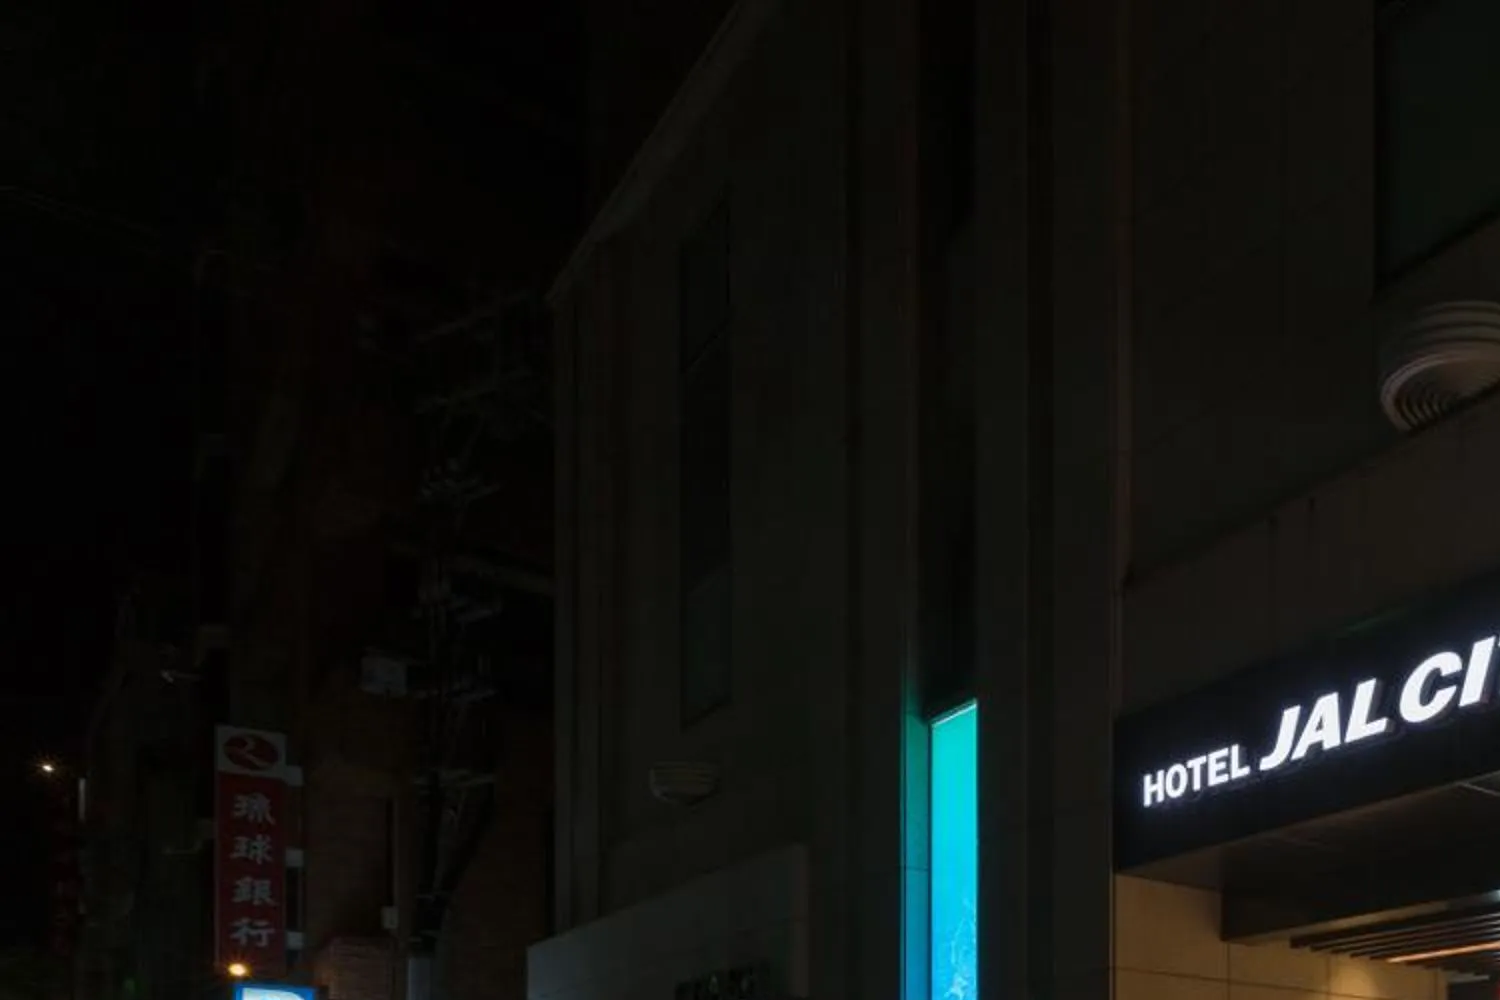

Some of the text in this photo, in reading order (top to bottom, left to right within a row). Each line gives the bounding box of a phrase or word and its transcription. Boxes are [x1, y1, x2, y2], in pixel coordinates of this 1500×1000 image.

[1143, 743, 1250, 807] HOTEL
[1259, 677, 1389, 771] JAL
[229, 791, 279, 948] 琉球銀行
